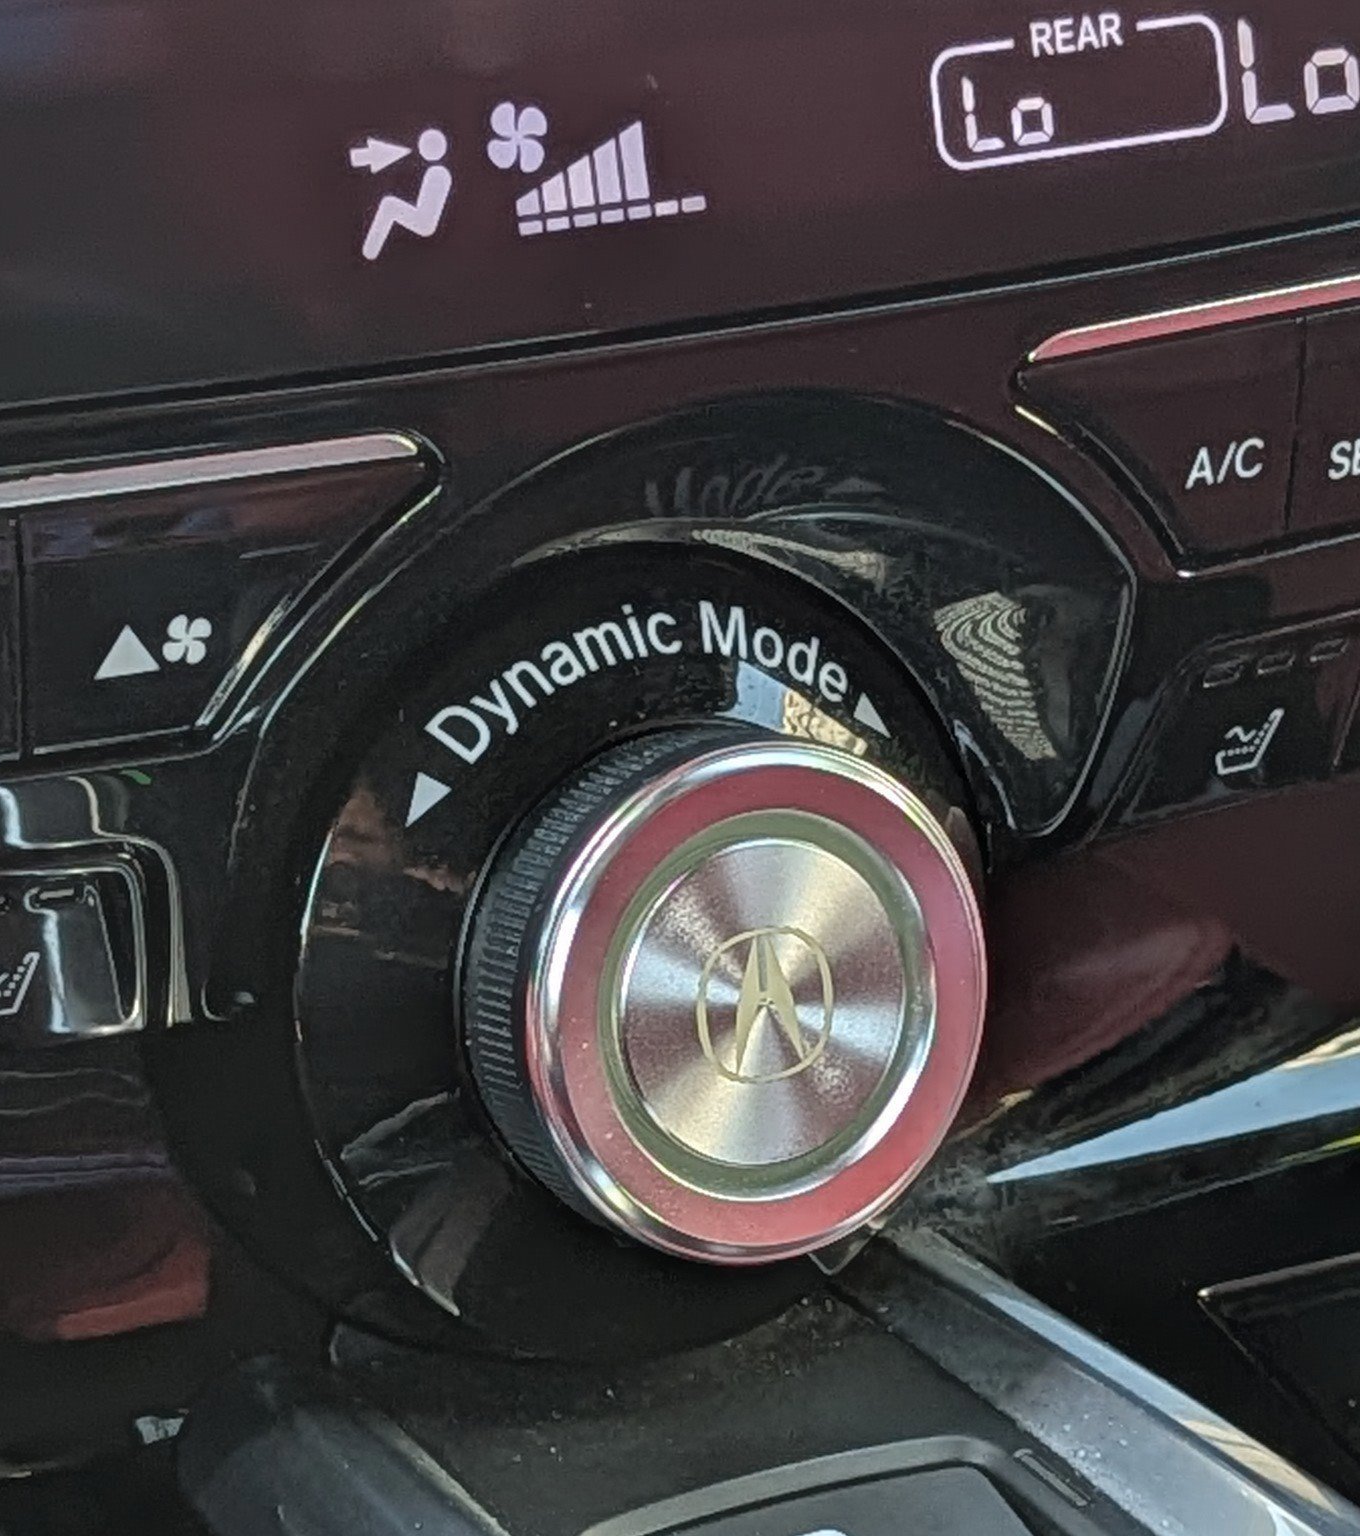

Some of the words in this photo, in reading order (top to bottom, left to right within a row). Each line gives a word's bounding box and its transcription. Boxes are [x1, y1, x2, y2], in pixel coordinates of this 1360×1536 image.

[1028, 11, 1125, 59] REAR
[961, 77, 1055, 153] Lo
[1184, 436, 1265, 490] A/C
[424, 603, 684, 766] Dynamic
[699, 600, 849, 703] Mode
